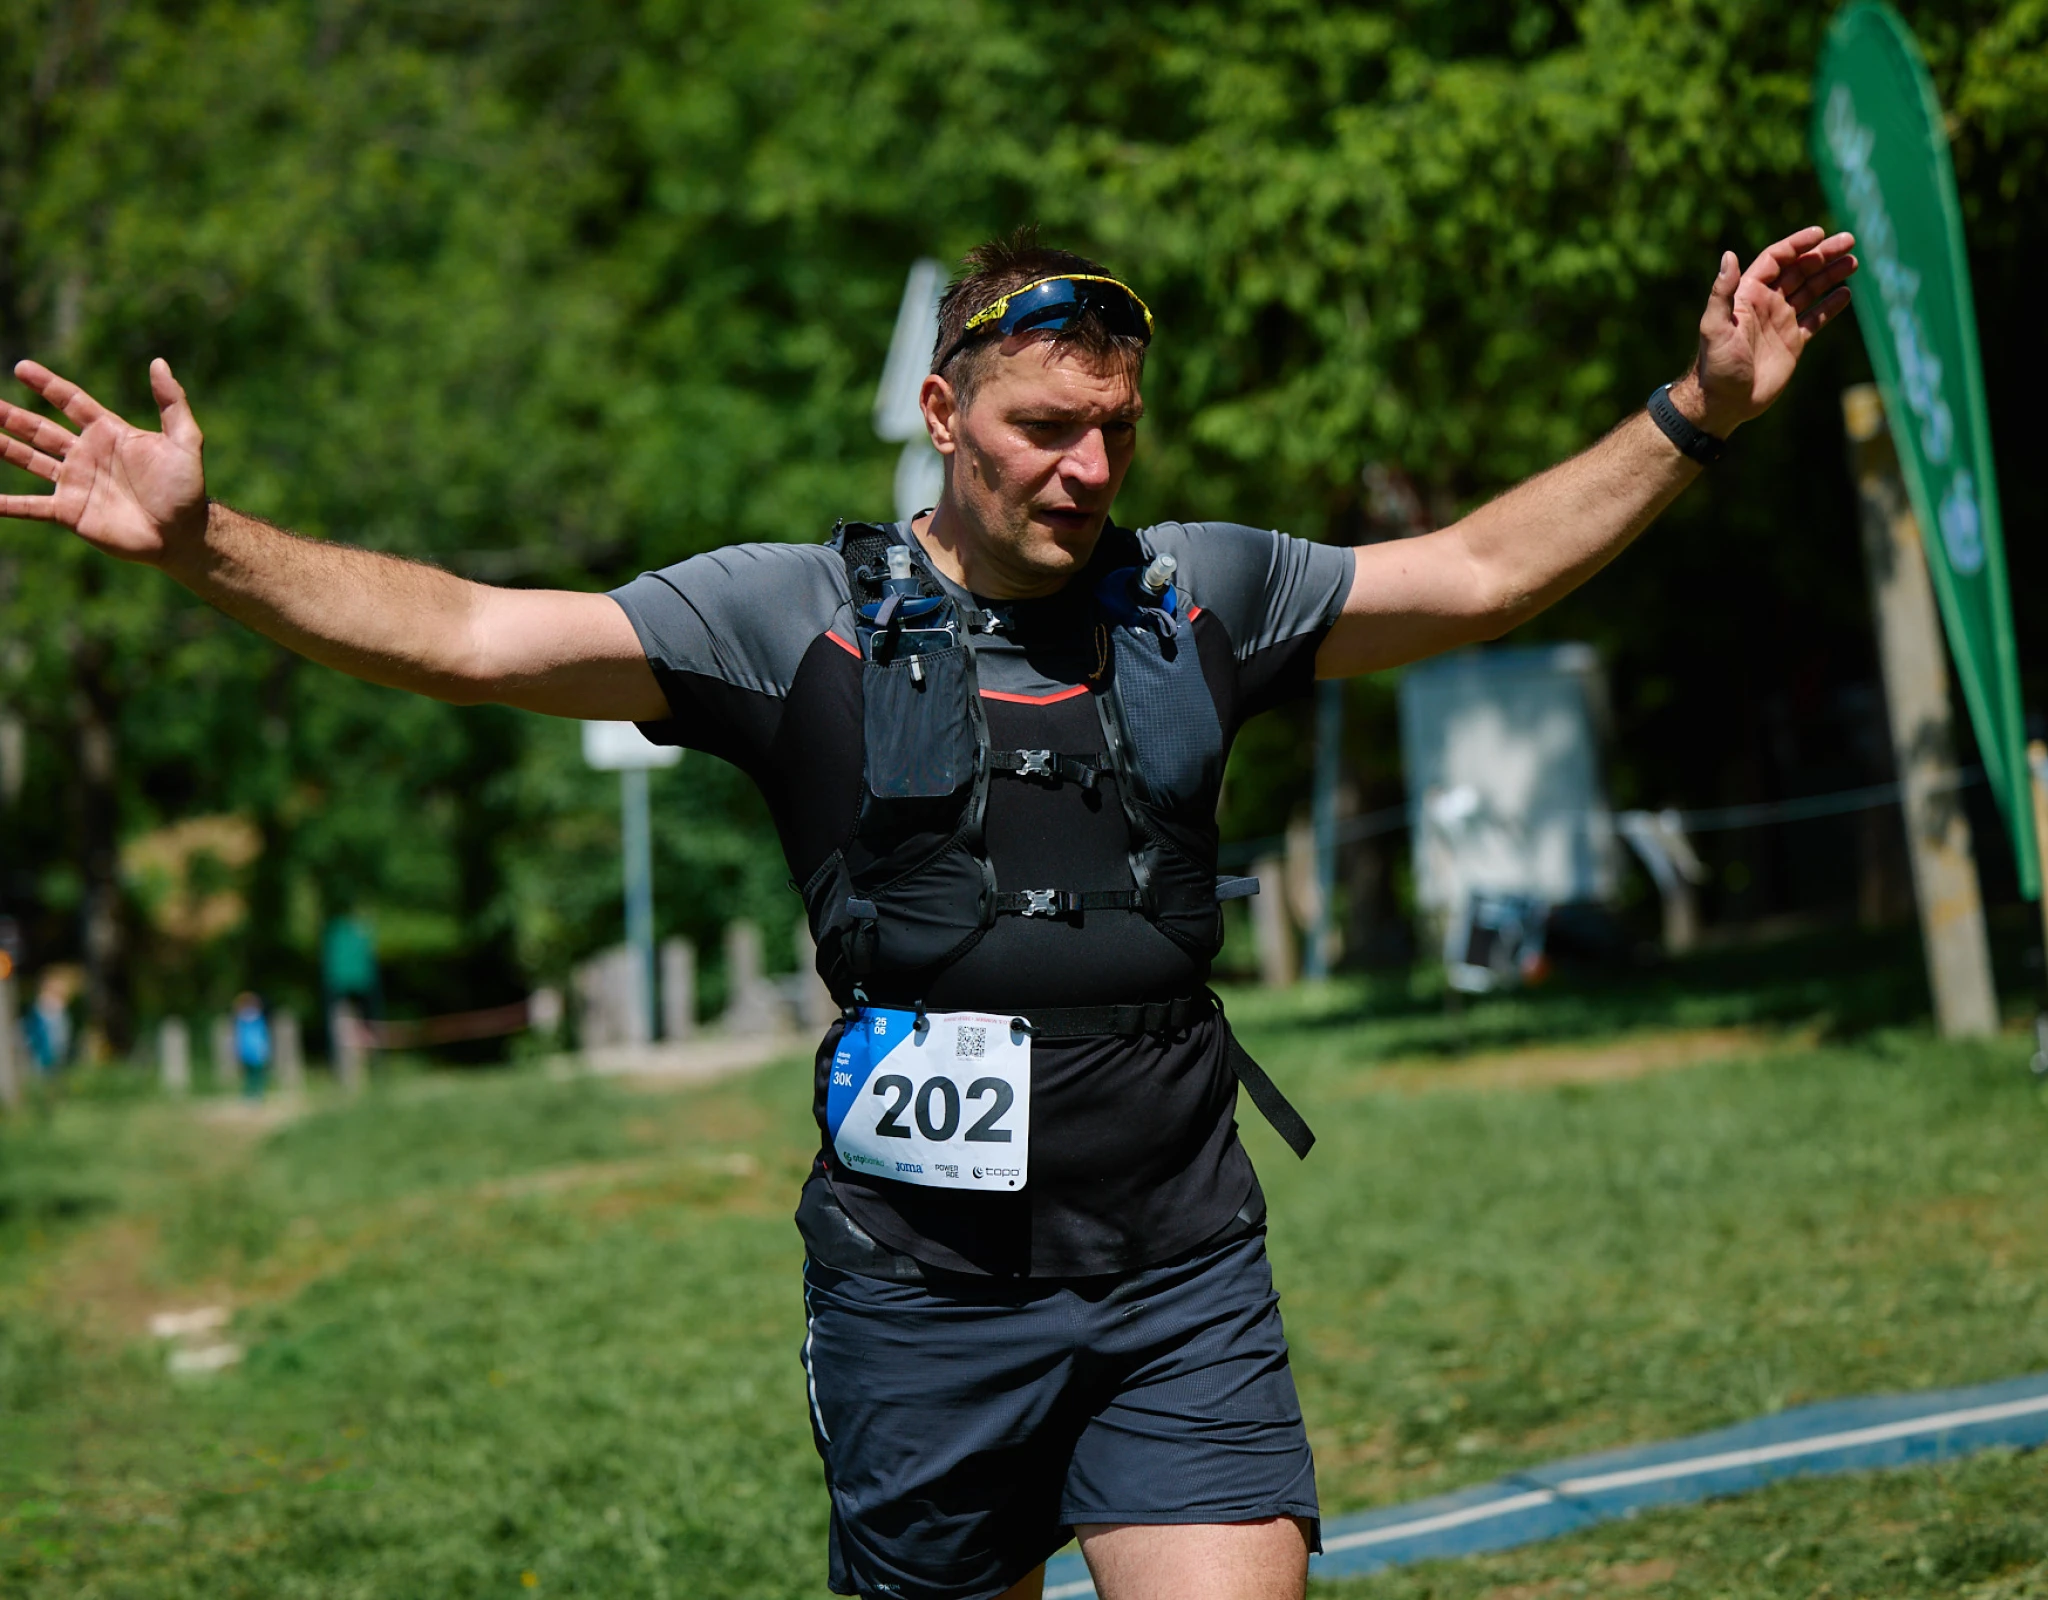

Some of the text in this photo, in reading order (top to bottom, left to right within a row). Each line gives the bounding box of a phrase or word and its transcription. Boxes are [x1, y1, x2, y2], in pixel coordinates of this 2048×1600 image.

[875, 1016, 887, 1027] 25
[874, 1026, 886, 1035] 05
[833, 1071, 852, 1087] 30K
[873, 1074, 1014, 1142] 202
[935, 1164, 959, 1172] POWER
